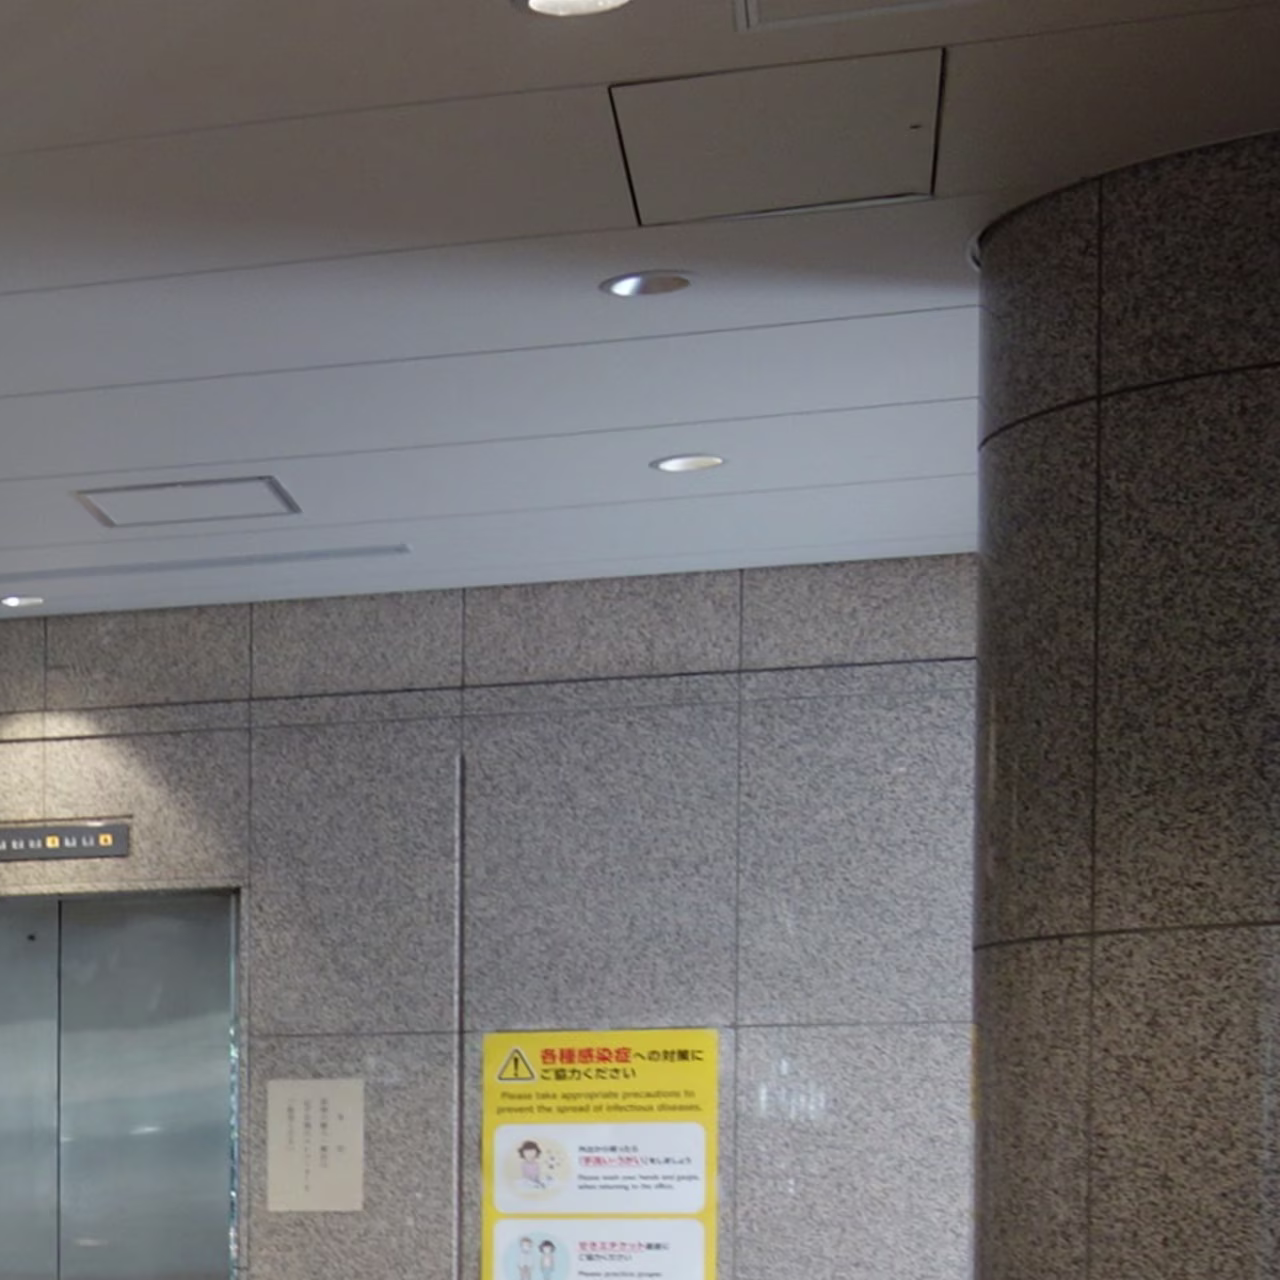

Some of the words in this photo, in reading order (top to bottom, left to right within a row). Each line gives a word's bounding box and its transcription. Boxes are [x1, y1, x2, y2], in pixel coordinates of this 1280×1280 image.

[540, 1047, 704, 1064] 各種感染症への対策に
[540, 1068, 636, 1081] ご協力ください
[501, 1091, 532, 1100] Please
[536, 1091, 556, 1100] take
[561, 1091, 619, 1102] appropriate
[622, 1090, 680, 1101] precautions
[684, 1090, 695, 1098] to
[496, 1105, 533, 1114] prevent
[537, 1105, 552, 1113] the
[556, 1104, 590, 1114] spread
[593, 1104, 603, 1112] of
